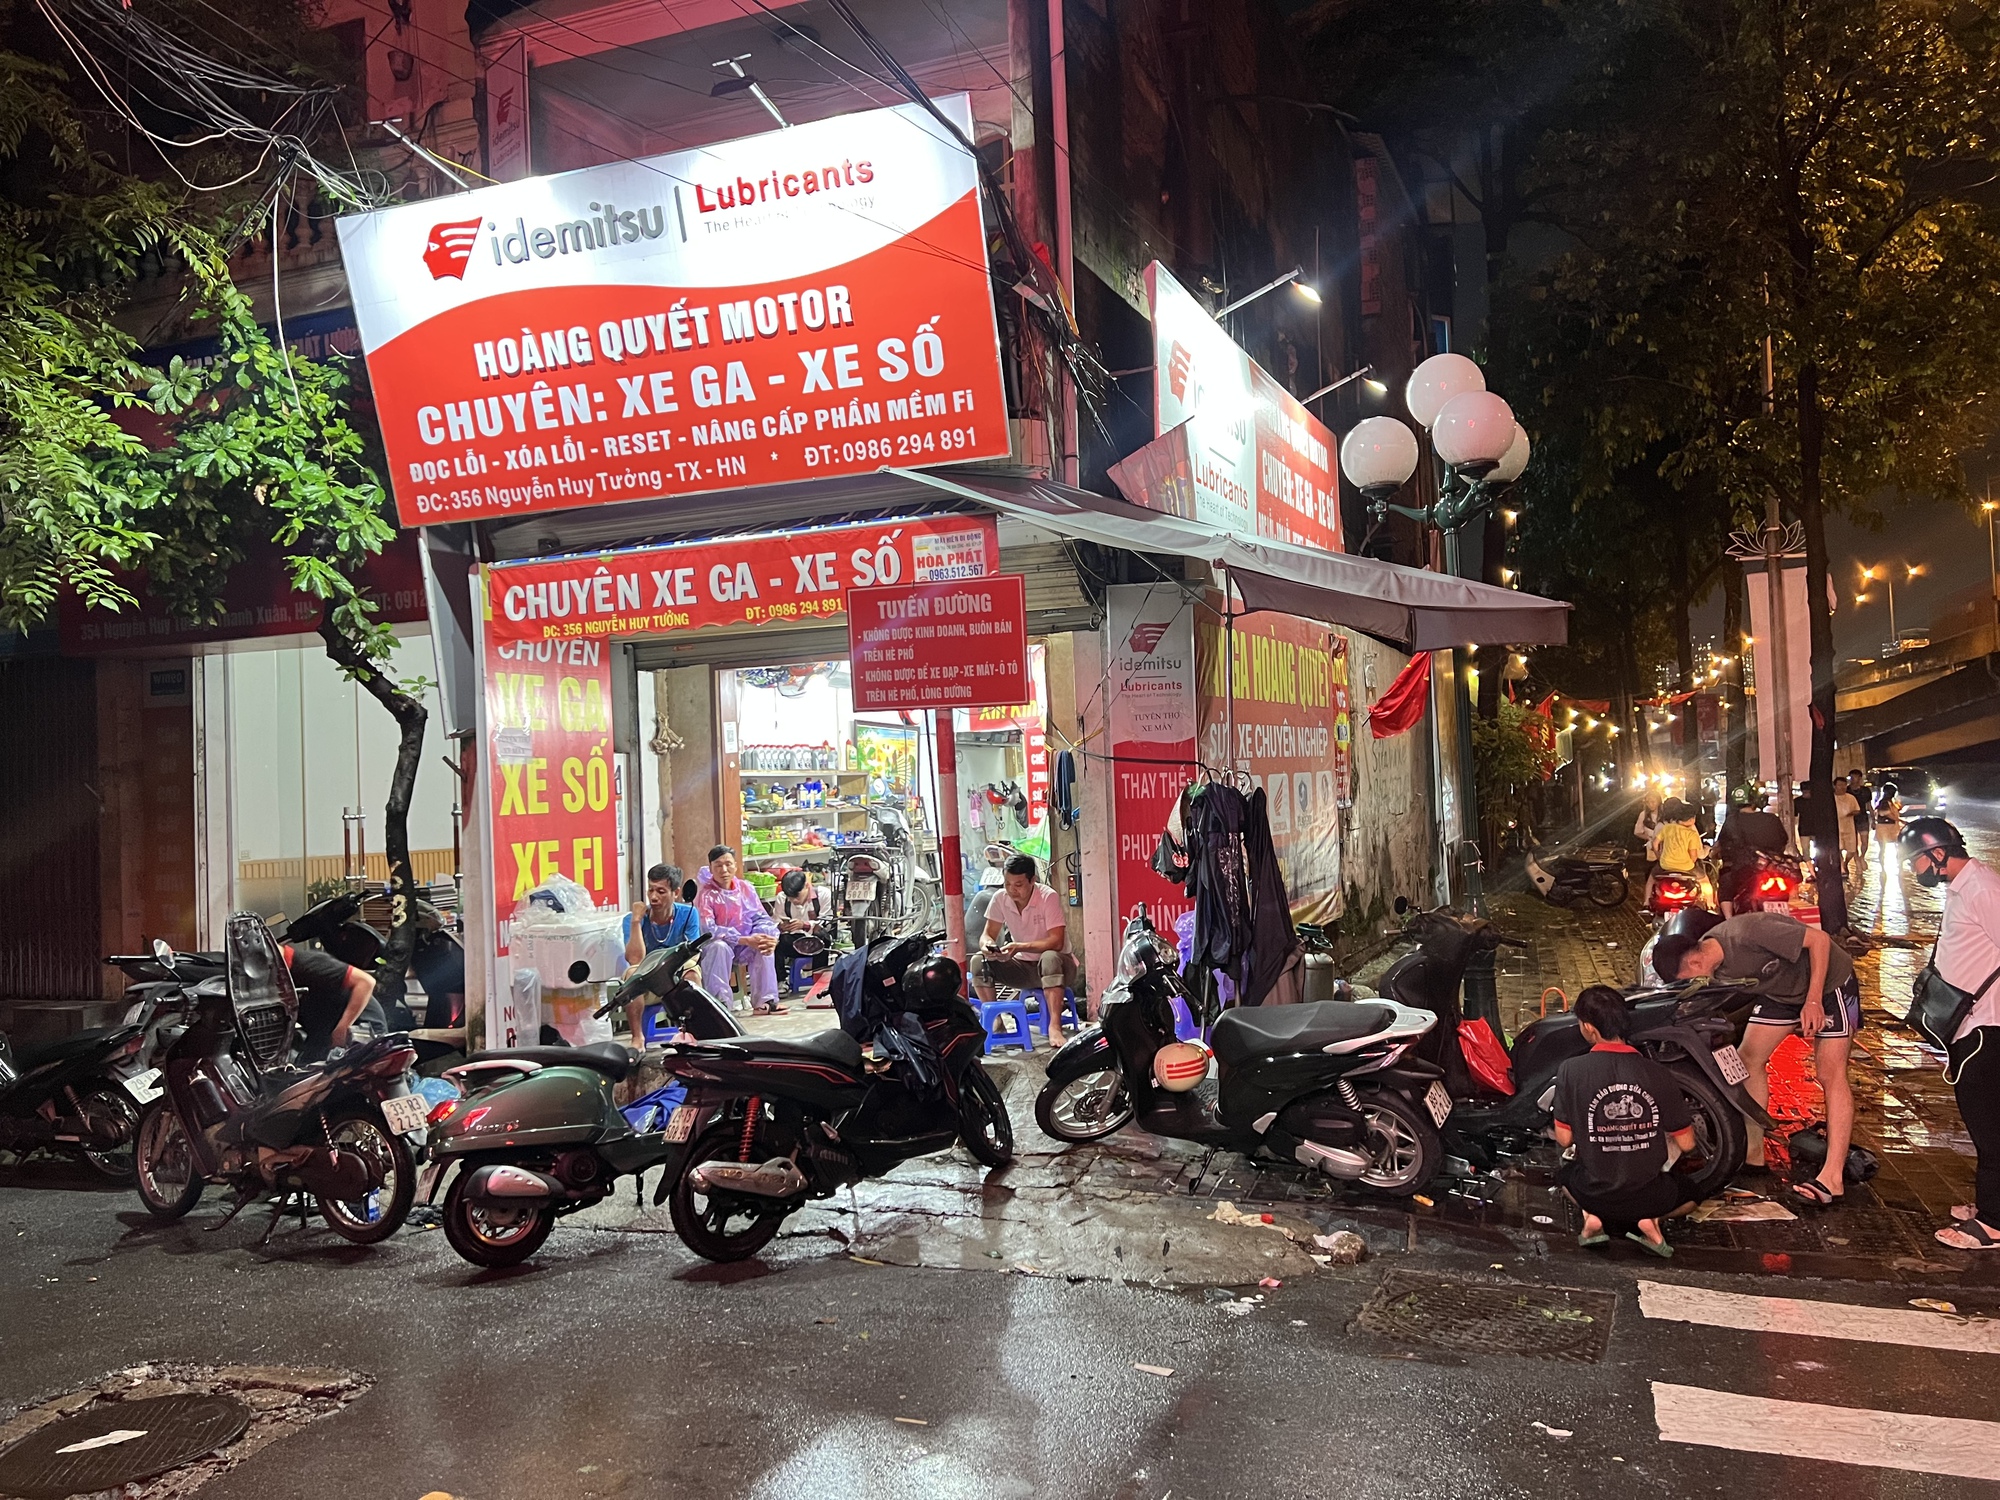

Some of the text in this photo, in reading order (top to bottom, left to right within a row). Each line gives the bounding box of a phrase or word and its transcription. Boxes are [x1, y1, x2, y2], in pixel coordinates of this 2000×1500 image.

[487, 159, 874, 266] idemitsu Lubricants
[473, 285, 854, 379] HOÀNG QUYẾT MOTOR
[417, 381, 607, 445] CHUYÊN:
[616, 371, 679, 418] XE
[690, 361, 756, 408] GA
[798, 344, 863, 394] XE
[877, 315, 944, 382] SỐ
[409, 460, 450, 485] ĐỌC
[454, 448, 487, 477] LỖI
[504, 444, 547, 470] XÓA
[551, 435, 585, 465] LỖI
[604, 429, 672, 457] RESET
[692, 419, 757, 447] NÂNG
[762, 406, 808, 437] CẤP
[814, 397, 881, 430] PHẦN
[886, 389, 947, 422] MỀM
[952, 390, 974, 413] Fi
[486, 477, 555, 506] Nguyễn
[557, 477, 594, 498] Huy
[596, 468, 662, 492] Tưởng
[675, 461, 702, 481] TX
[716, 455, 746, 477] HN
[897, 432, 935, 457] 294
[940, 426, 976, 449] 891
[1195, 453, 1248, 510] Lubricants
[504, 567, 641, 621] CHUYÊN
[651, 568, 698, 608] XE
[709, 562, 759, 602] GA
[792, 552, 840, 593] XE
[851, 529, 903, 586] SỐ
[917, 548, 982, 569] HÒA PHÁT
[929, 563, 984, 580] 0963.512.567
[543, 598, 843, 638] ĐC: 356 NGUYỄN HUY TƯỞNG ĐT: 0986 294 891
[877, 591, 992, 619] TUYẾN ĐƯỜNG
[863, 628, 889, 642] KHÔNG
[892, 627, 913, 642] ĐƯỢC
[915, 625, 935, 639] KINH
[937, 624, 968, 637] DOANH,
[969, 620, 993, 635] BUÔN
[994, 621, 1012, 633] BÁN
[864, 643, 914, 662] TRÊN HÈ PHỐ
[1120, 656, 1181, 671] idemitsu
[1232, 629, 1250, 700] GA
[1252, 624, 1296, 705] HOÀNG
[1298, 633, 1330, 713] QUYẾT
[866, 669, 892, 682] KHÔNG
[894, 667, 916, 683] ĐƯỢC
[917, 662, 929, 680] ĐỂ
[930, 667, 940, 679] XE
[1120, 681, 1182, 692] Lubricants
[495, 672, 607, 732] XE GA
[866, 683, 972, 702] TRÊN HÈ PHỐ, LÒNG ĐƯỜNG
[1154, 723, 1173, 731] MÁY
[1209, 711, 1236, 761] SỬ
[1237, 723, 1253, 759] XE
[1254, 718, 1296, 758] CHUYÊN
[1297, 720, 1329, 763] NGHIỆP
[499, 757, 549, 816] XE
[561, 738, 609, 813] SỐ
[1122, 772, 1156, 799] THAY
[511, 837, 603, 901] XE FI
[1122, 835, 1149, 868] PHỤ
[389, 1098, 422, 1116] 33-R3
